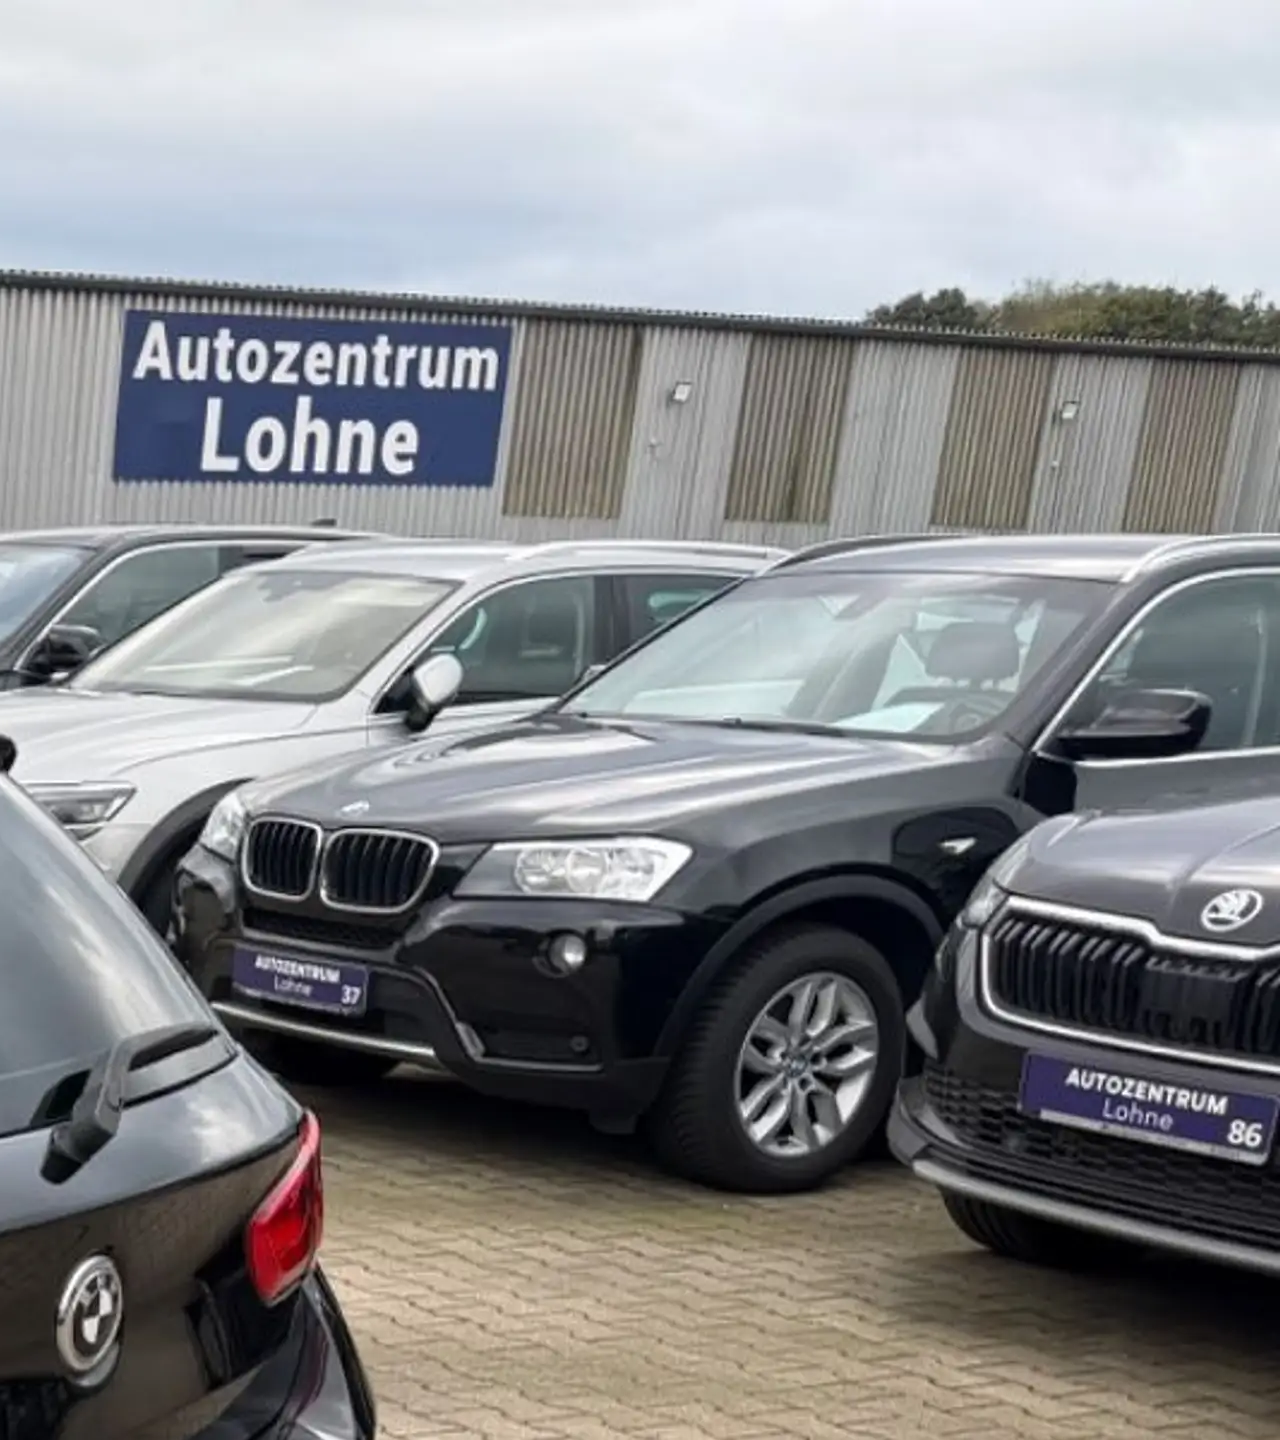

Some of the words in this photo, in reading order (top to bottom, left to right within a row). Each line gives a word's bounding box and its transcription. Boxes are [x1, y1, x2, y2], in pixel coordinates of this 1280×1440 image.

[132, 320, 498, 391] Autozentrum
[200, 395, 419, 476] Lohne
[254, 954, 340, 983] AUTOZENTRUM
[341, 984, 361, 1005] 37
[1065, 1067, 1228, 1116] AUTOZENTRUM
[1102, 1099, 1174, 1132] Lohne
[1226, 1119, 1263, 1148] 86
